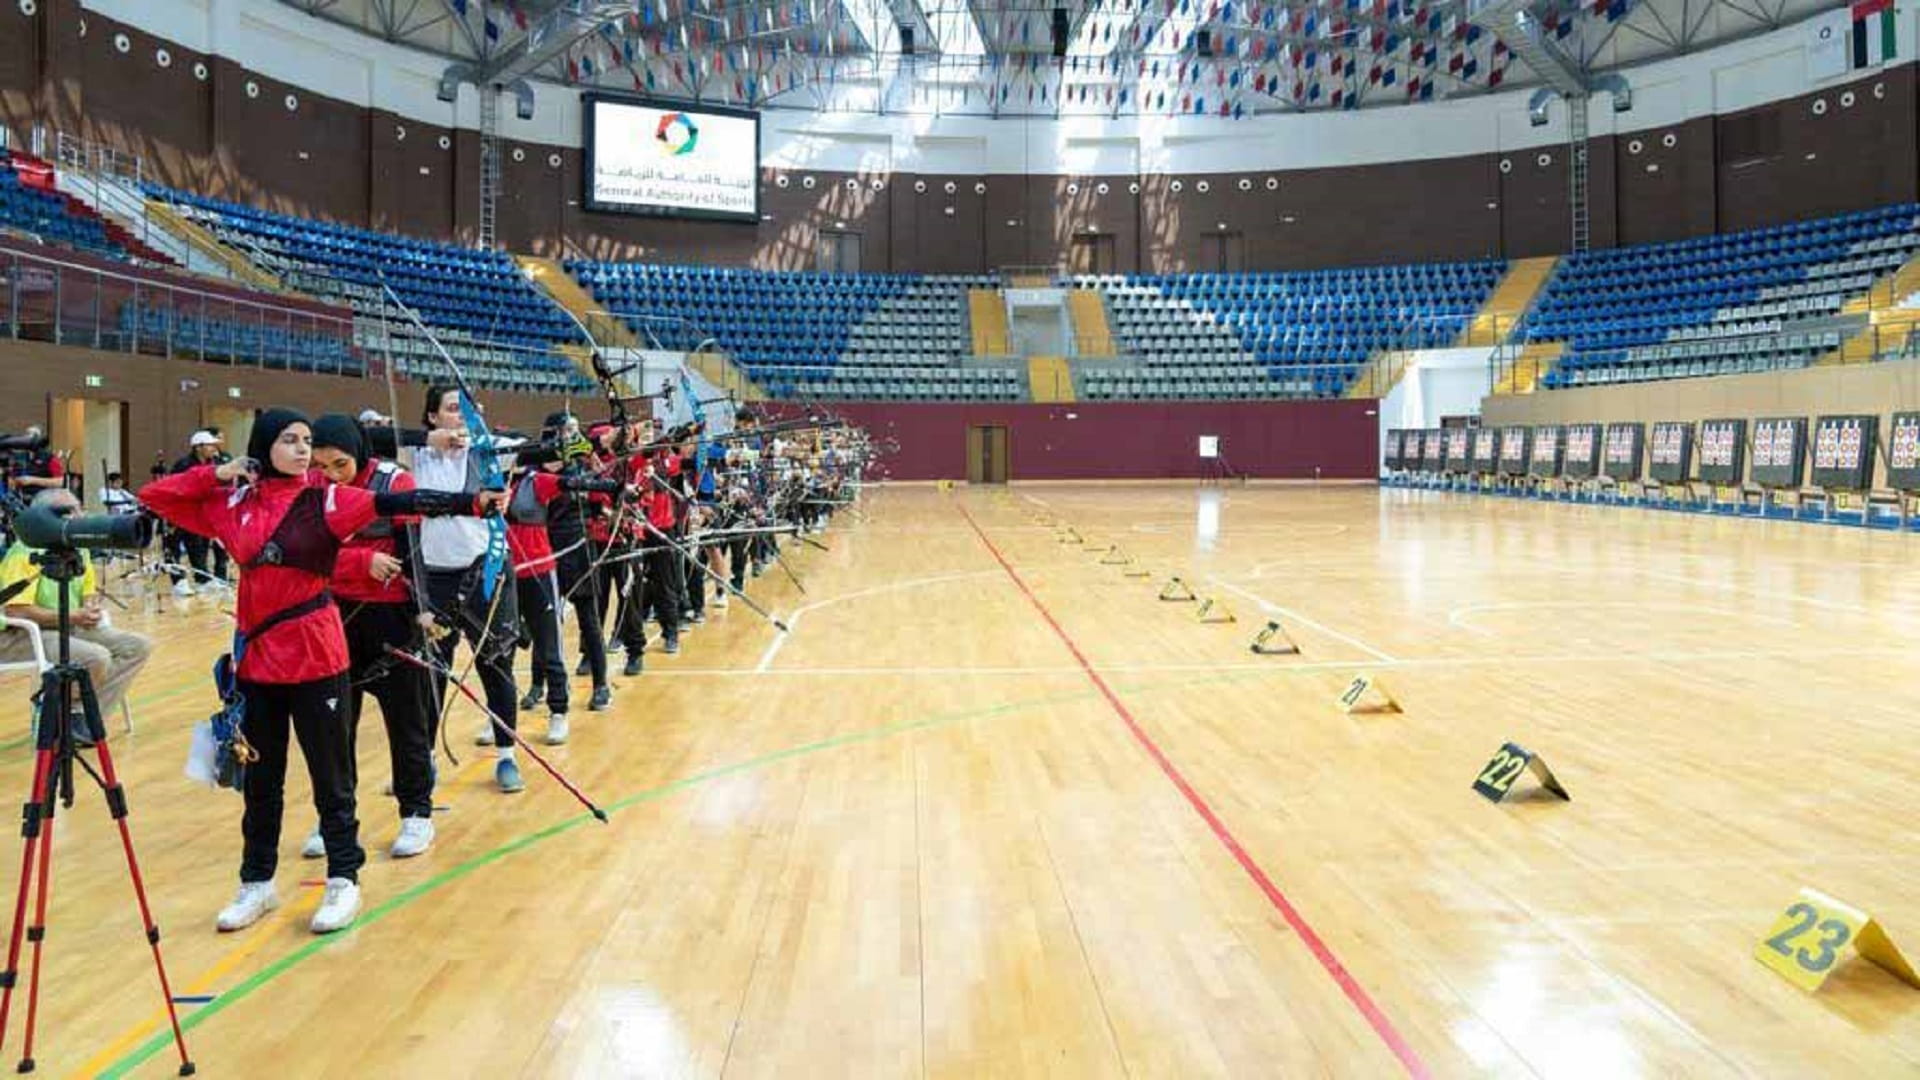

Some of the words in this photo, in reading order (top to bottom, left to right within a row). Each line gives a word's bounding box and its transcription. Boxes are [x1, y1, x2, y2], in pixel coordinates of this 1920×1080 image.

[596, 183, 642, 197] General
[647, 188, 699, 204] Authority
[703, 192, 714, 204] of
[717, 192, 752, 207] Sports
[1342, 678, 1367, 705] 21
[1479, 750, 1525, 791] 22
[1765, 903, 1850, 972] 23
